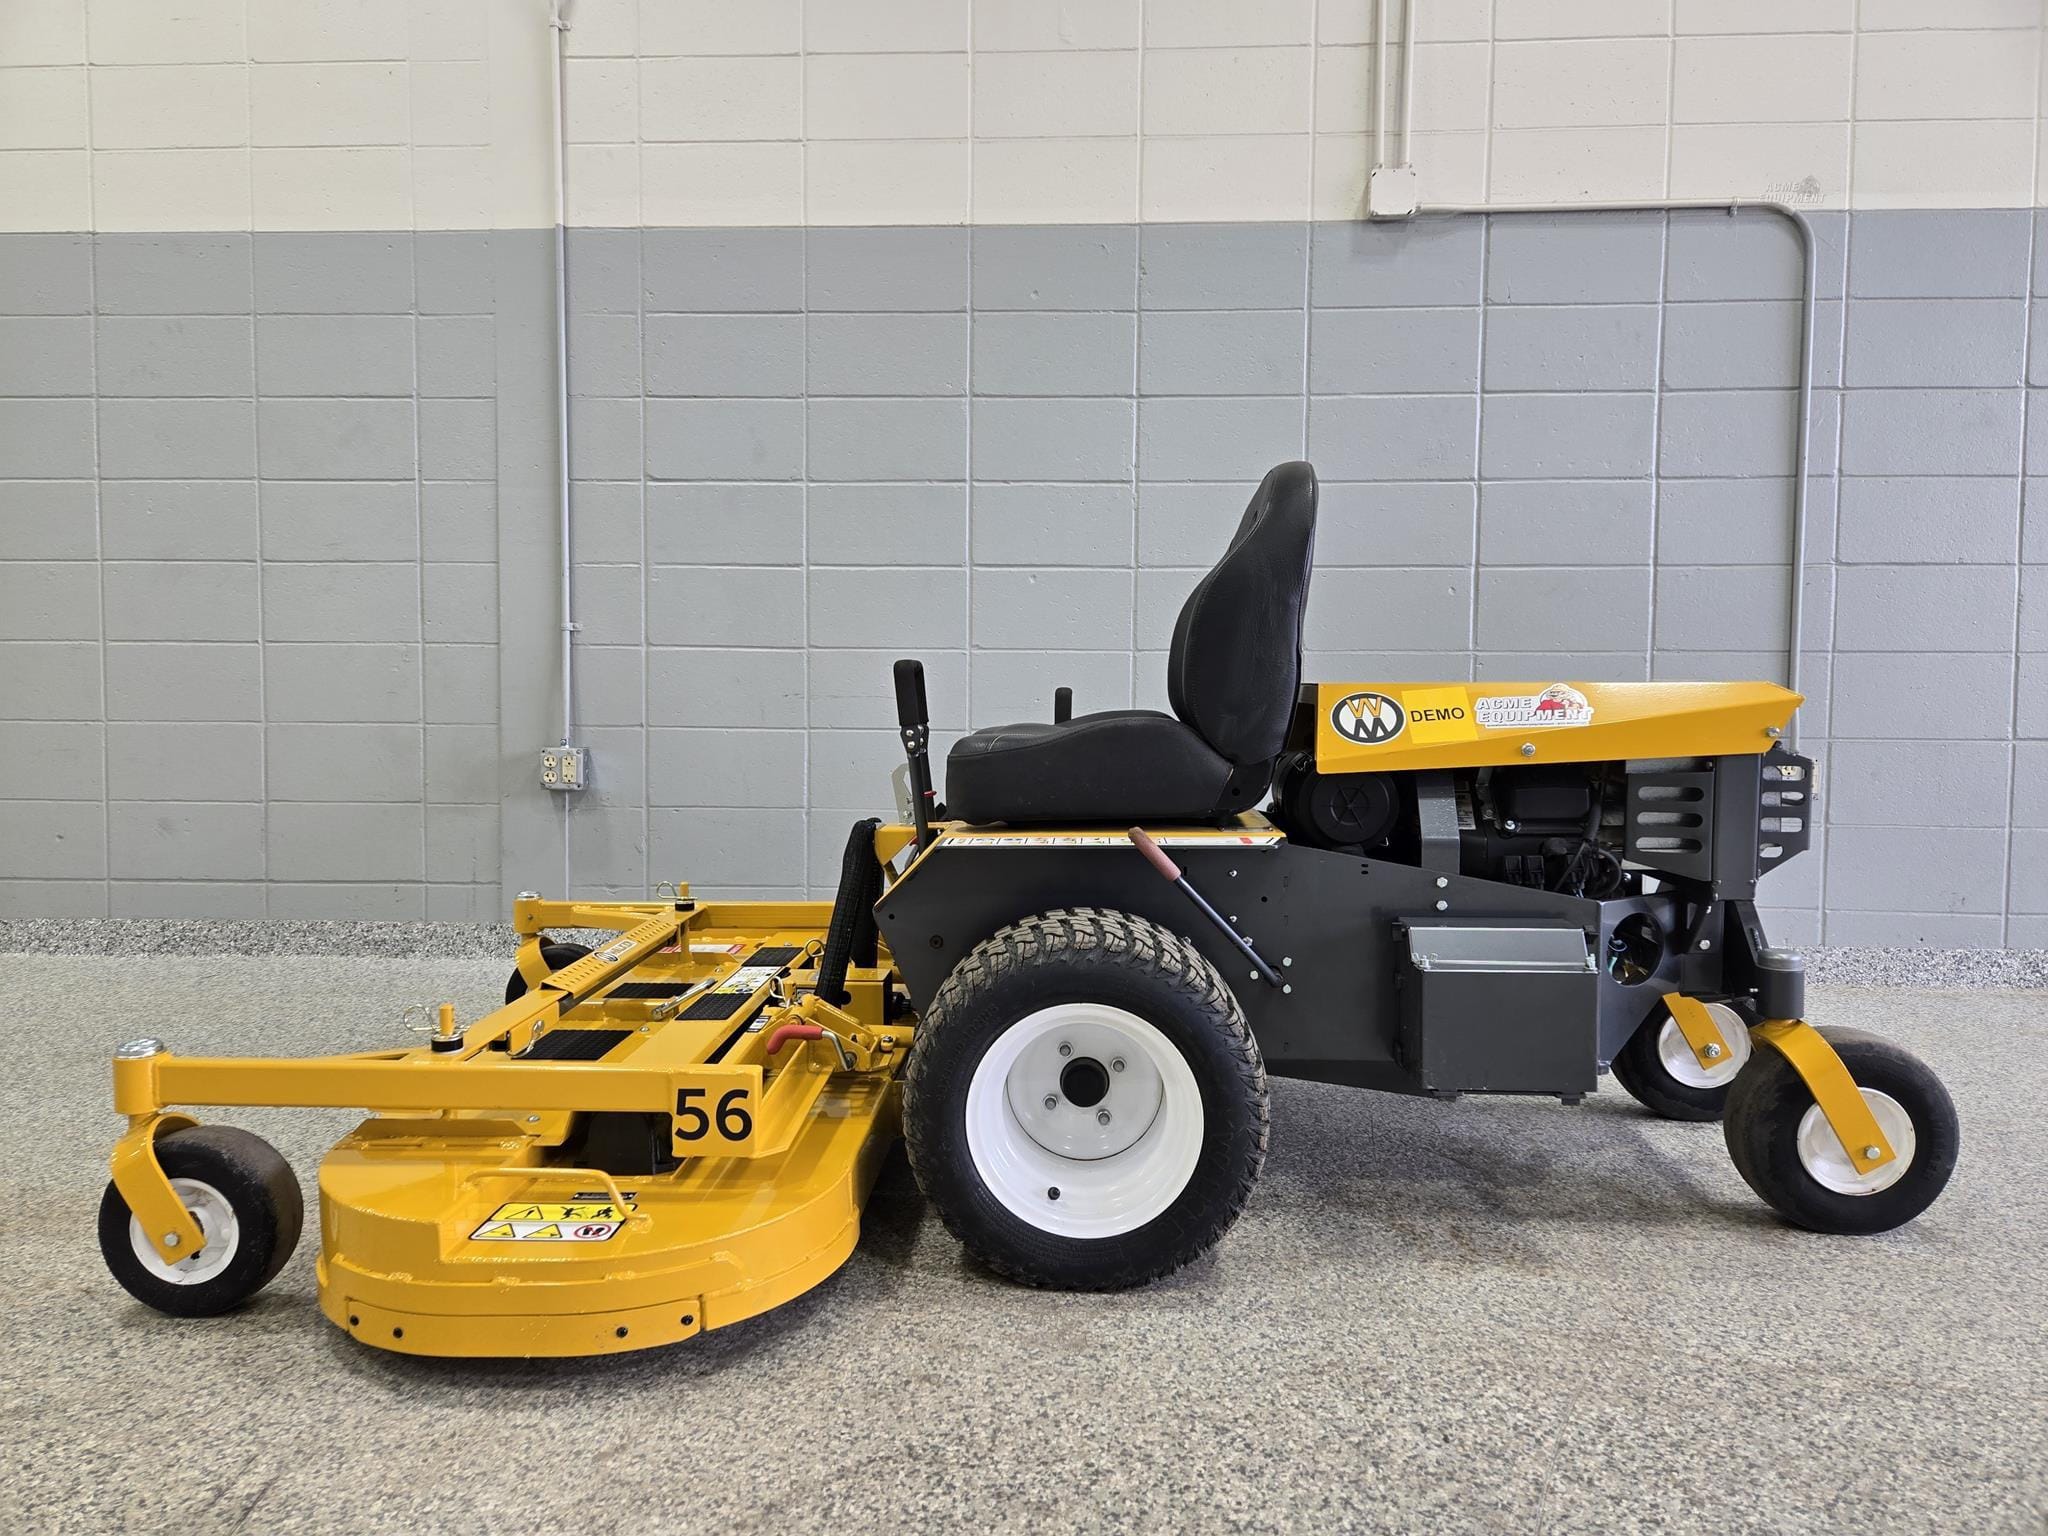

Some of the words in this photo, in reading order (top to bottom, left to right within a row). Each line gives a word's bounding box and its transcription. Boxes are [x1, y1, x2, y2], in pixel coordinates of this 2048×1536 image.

[1477, 697, 1532, 710] ACME
[1410, 707, 1465, 722] DEMO
[1479, 707, 1594, 723] EQUIPMENT
[674, 1088, 753, 1142] 56
